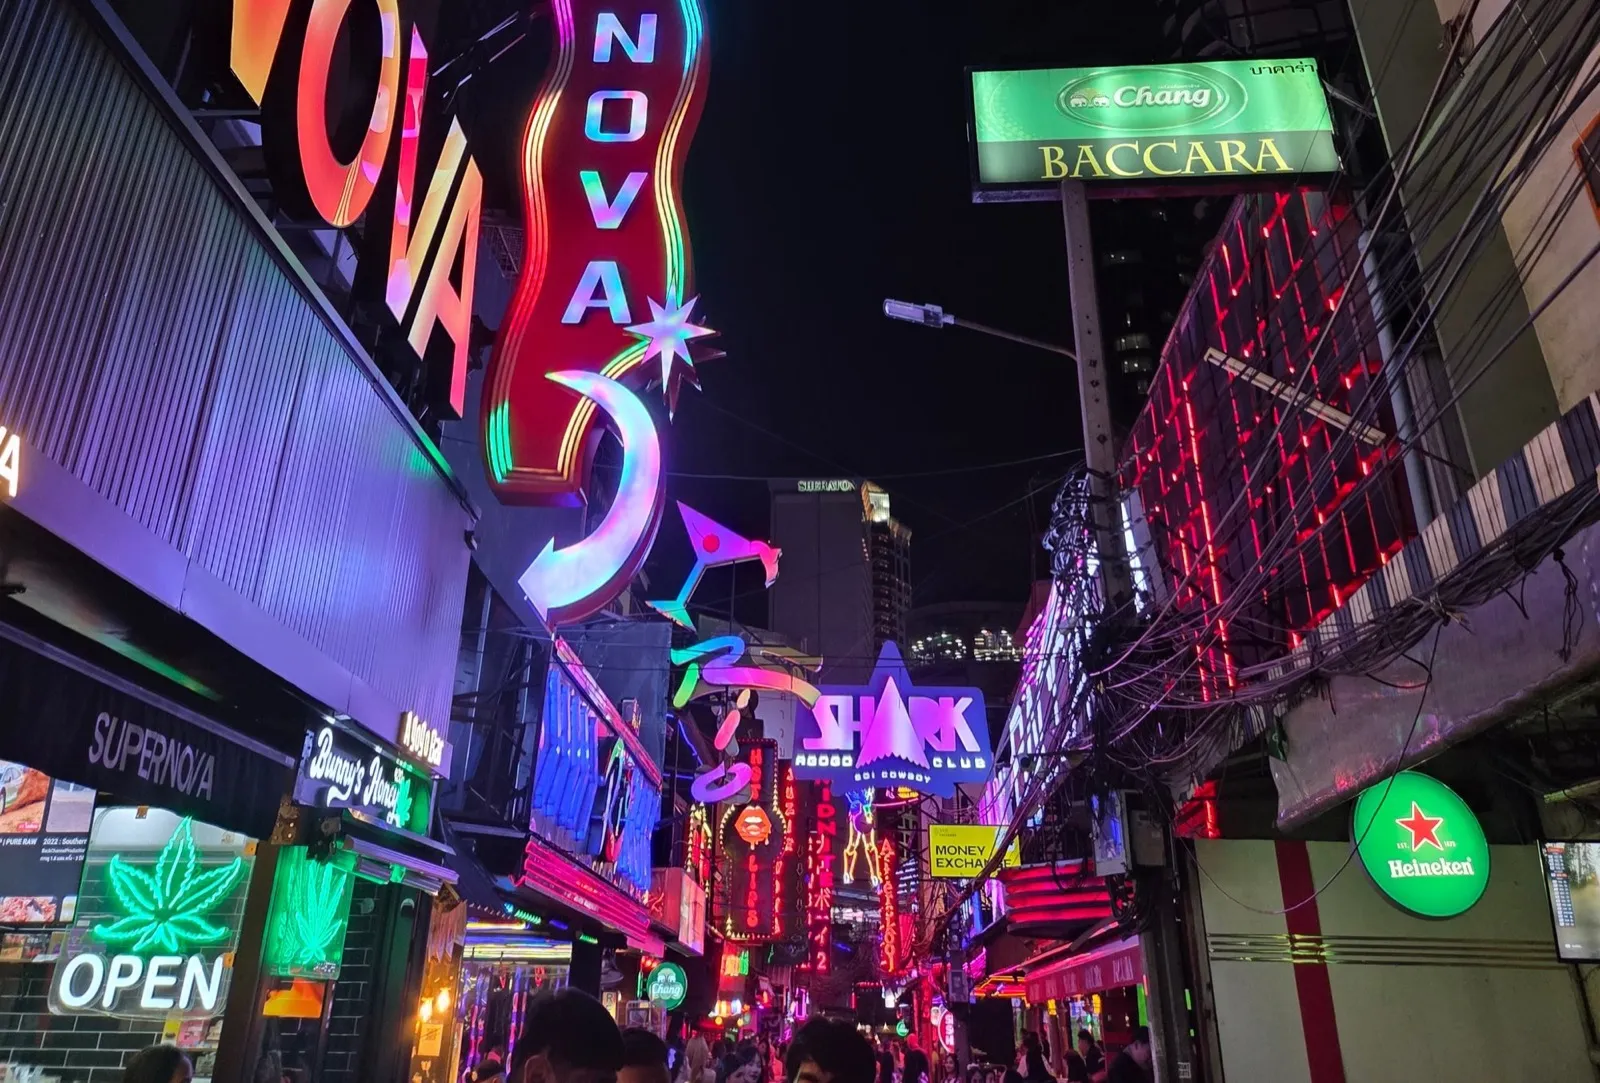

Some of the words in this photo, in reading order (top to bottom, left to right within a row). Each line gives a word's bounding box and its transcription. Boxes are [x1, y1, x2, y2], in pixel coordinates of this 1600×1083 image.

[1250, 61, 1315, 76] บาคาร่า
[1113, 84, 1212, 108] Chang
[561, 12, 657, 325] NOVA
[1039, 138, 1294, 180] BACCARA
[803, 678, 981, 762] SHARK
[310, 727, 365, 808] Bunny's
[794, 753, 853, 767] AGOGO
[932, 755, 986, 769] CLUB
[881, 770, 932, 785] COWBOY
[43, 838, 58, 846] 2022
[814, 779, 837, 887] IDNITE
[936, 844, 986, 856] MONEY
[936, 857, 1012, 869] EXCHAE
[1388, 856, 1475, 879] Heineken
[746, 854, 759, 928] LIPS
[59, 953, 224, 1011] OPEN
[652, 982, 683, 998] Chang
